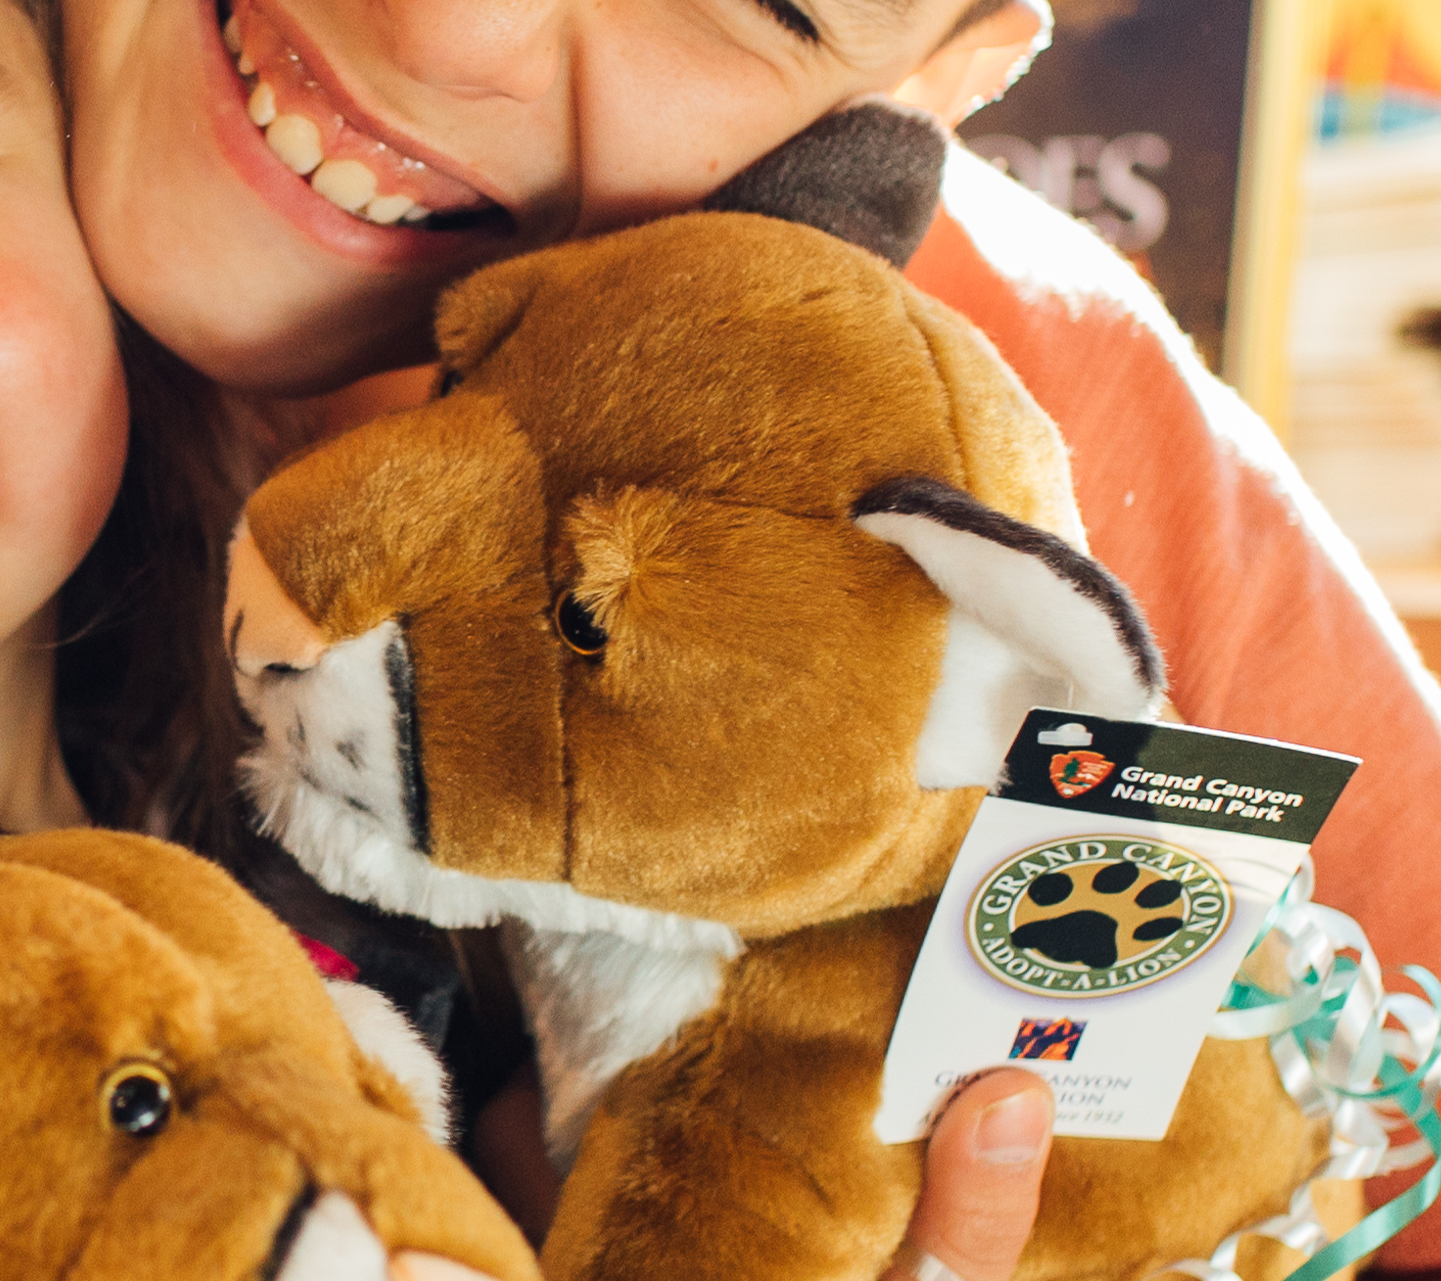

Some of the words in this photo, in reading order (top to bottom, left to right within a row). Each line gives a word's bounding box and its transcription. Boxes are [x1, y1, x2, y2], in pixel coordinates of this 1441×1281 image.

[1111, 783, 1224, 813] National
[1224, 799, 1285, 823] Park
[1120, 765, 1203, 792] Grand
[1205, 778, 1304, 808] Canyon
[982, 841, 1108, 916] GRAND
[1122, 843, 1222, 936] CANYON
[982, 936, 1183, 991] ADOPT-A-LION
[1046, 1071, 1132, 1090] ANYON
